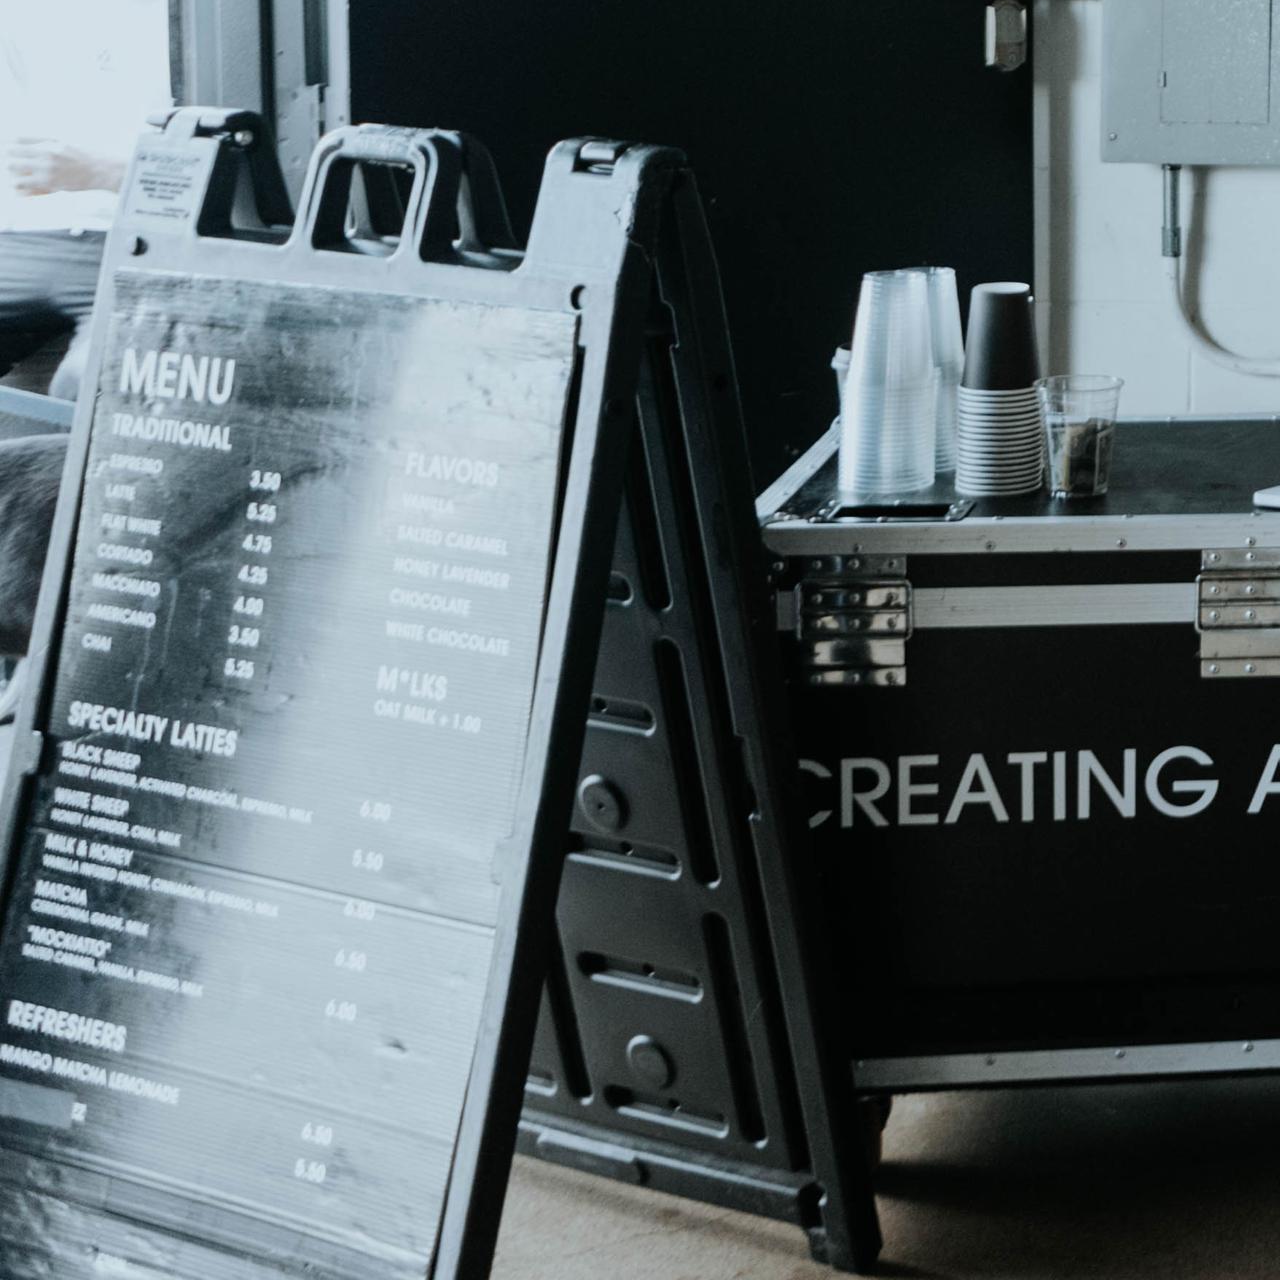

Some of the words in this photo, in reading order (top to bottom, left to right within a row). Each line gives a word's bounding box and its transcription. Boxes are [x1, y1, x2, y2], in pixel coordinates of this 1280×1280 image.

[119, 347, 236, 405] MENU
[111, 412, 233, 453] TRADITIONAL
[249, 470, 281, 492] 3.50
[404, 451, 499, 486] FLAVORS
[402, 493, 454, 514] VANILLA
[241, 533, 273, 555] 4.75
[397, 524, 443, 547] SALTED
[444, 531, 509, 557] CARAMEL
[392, 557, 440, 579] HONEY
[441, 563, 511, 591] LAVENDER
[388, 587, 473, 617] CHOCOLATE
[385, 620, 425, 641] WHITE
[426, 627, 511, 656] CHOCOLATE
[67, 700, 168, 745] SPECIALTY
[169, 720, 239, 757] LATTES
[373, 698, 402, 719] OAT
[402, 703, 437, 725] MILK
[451, 711, 483, 735] 1.00
[61, 741, 103, 766] BLACK
[34, 879, 88, 907] MATCHA
[7, 999, 127, 1053] REFRESHERS
[0, 1043, 52, 1072] MANGO
[51, 1056, 107, 1087] MATCHA
[106, 1071, 181, 1107] LEMONADE
